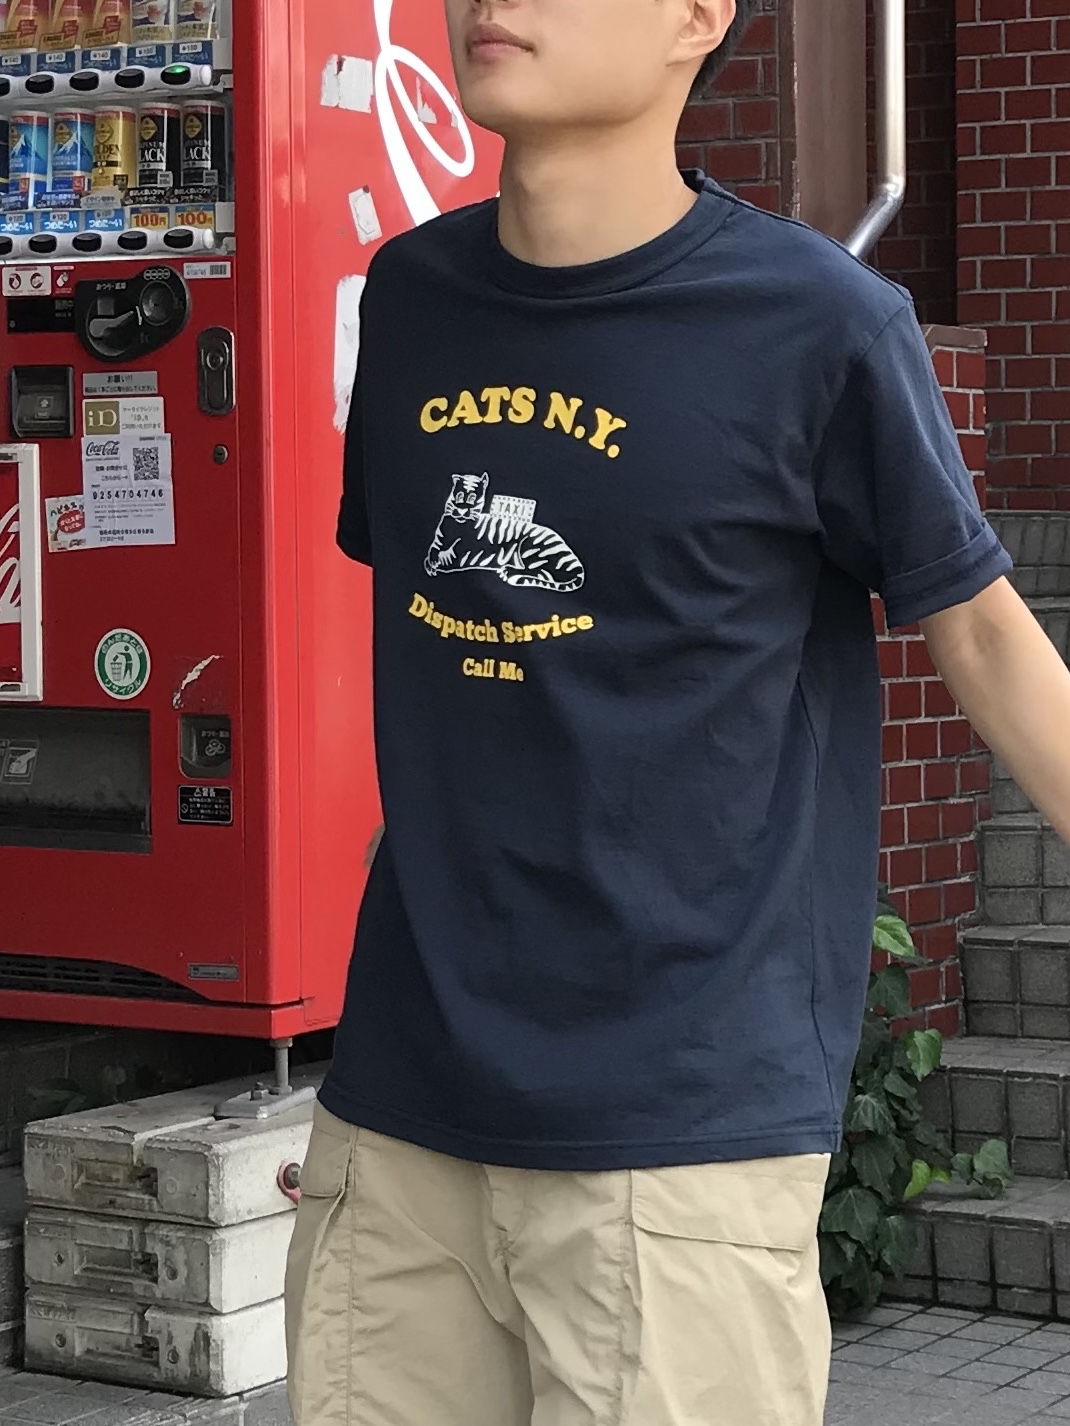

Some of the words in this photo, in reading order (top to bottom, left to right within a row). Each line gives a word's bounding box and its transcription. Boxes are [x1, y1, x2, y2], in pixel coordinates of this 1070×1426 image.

[88, 409, 117, 427] iD
[420, 386, 537, 433] CATS
[543, 392, 627, 458] N.Y.
[500, 501, 525, 516] TAXI
[408, 592, 499, 643] Dispatch
[501, 614, 594, 643] Service
[463, 657, 495, 677] Call
[499, 661, 524, 681] Me
[105, 679, 141, 695] リサイクル
